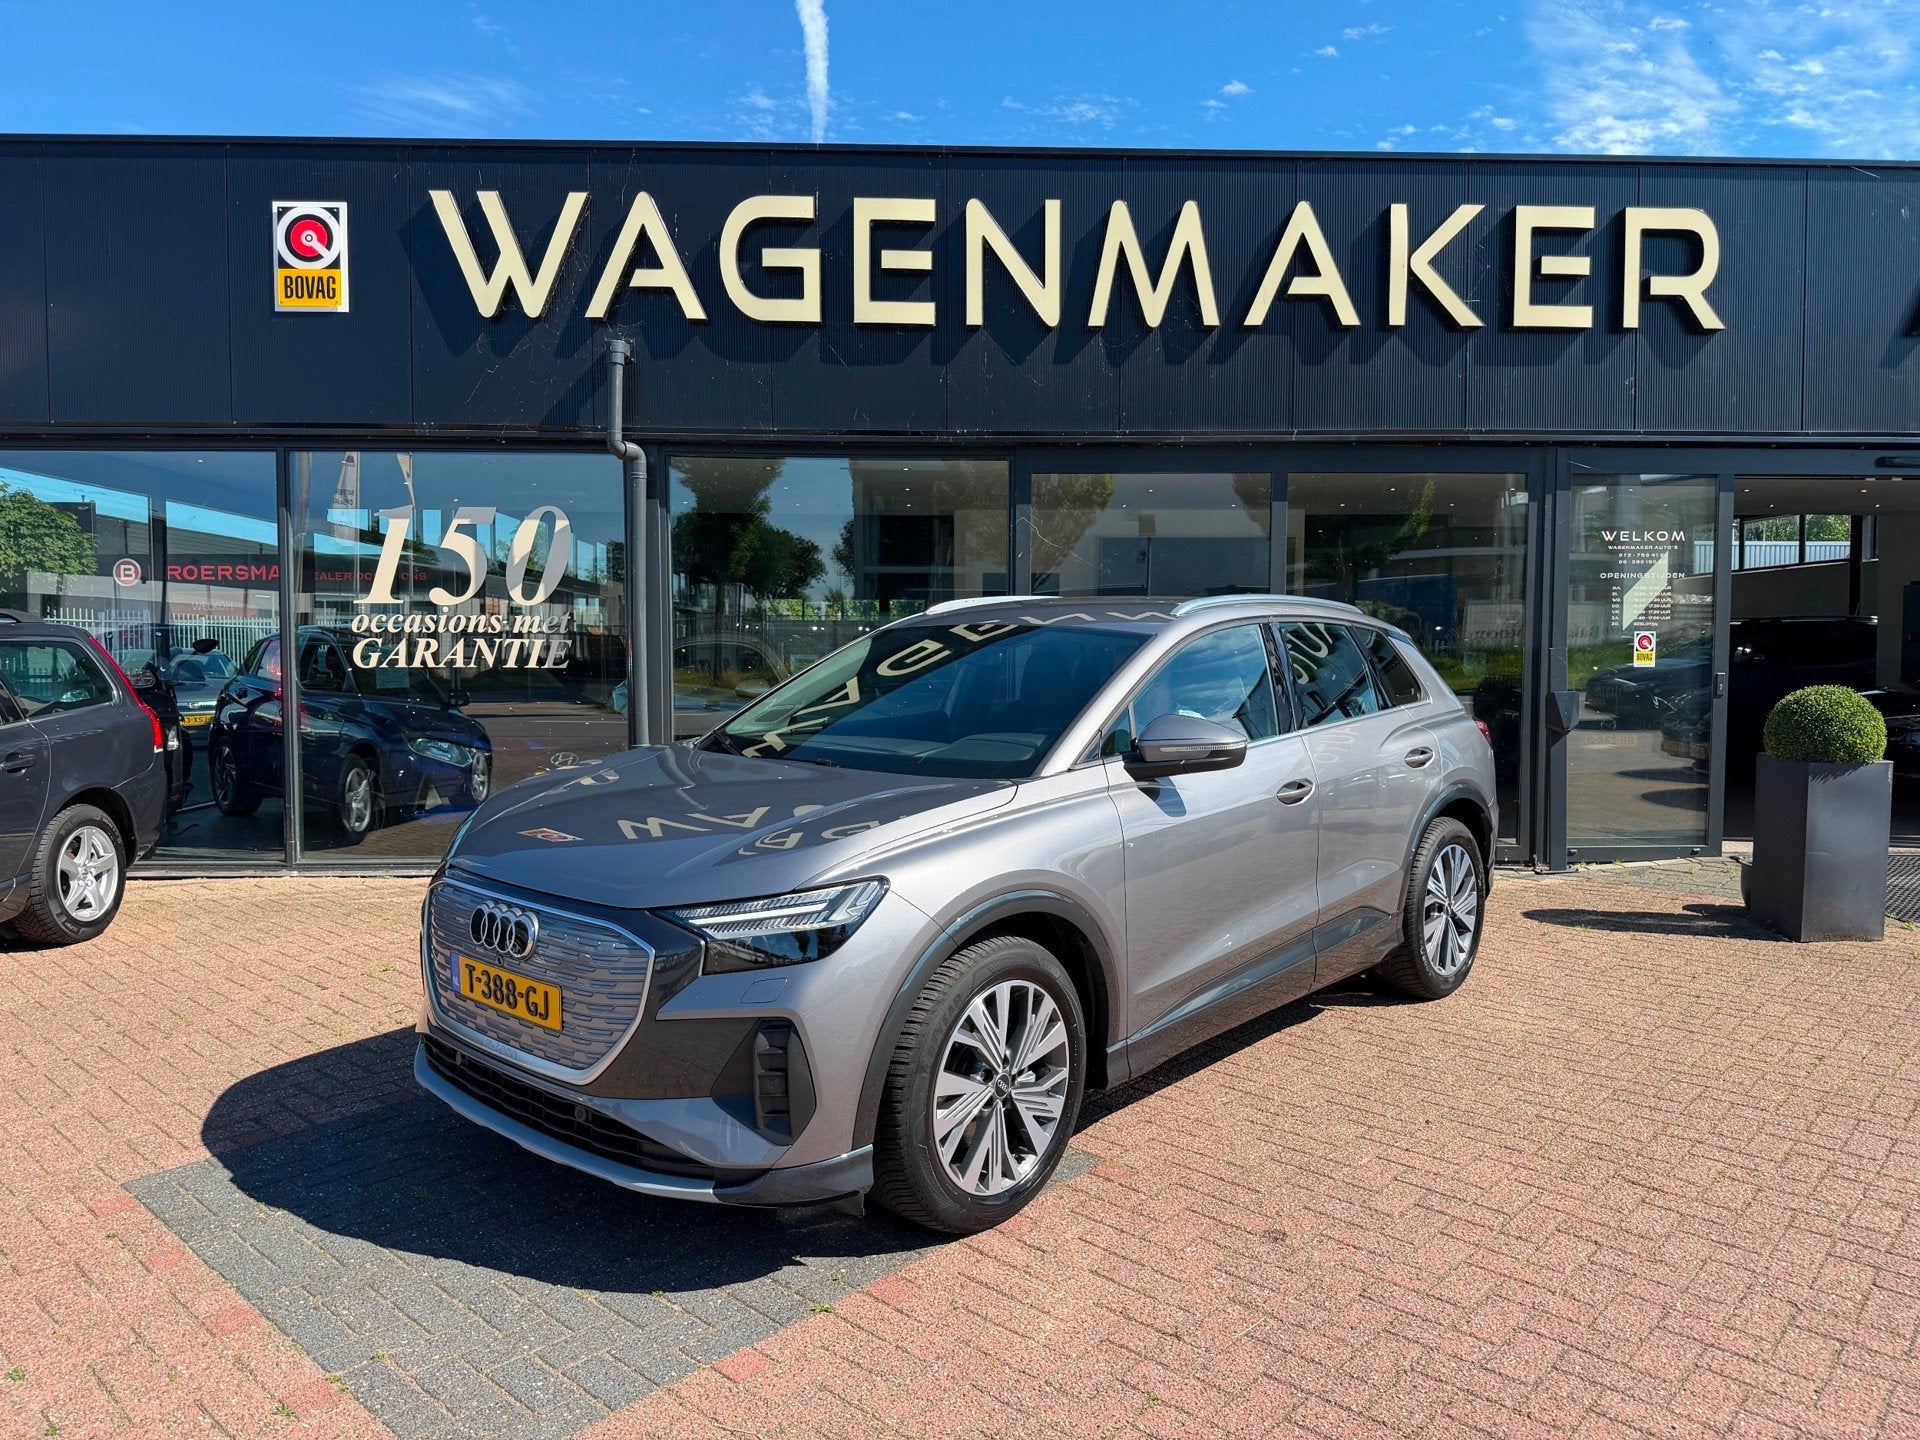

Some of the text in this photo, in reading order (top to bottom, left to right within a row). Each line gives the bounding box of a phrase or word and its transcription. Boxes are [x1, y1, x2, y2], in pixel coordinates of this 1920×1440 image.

[428, 190, 1726, 330] WAGENMAKER
[284, 275, 336, 299] BOVAG
[1602, 531, 1685, 541] WELKOM
[353, 505, 572, 606] 150
[147, 565, 279, 581] ROERSMA
[351, 606, 572, 633] occasions met
[352, 638, 572, 669] GARANTIE
[1637, 653, 1653, 661] BOVAG
[465, 963, 549, 1020] T-388-GJ
